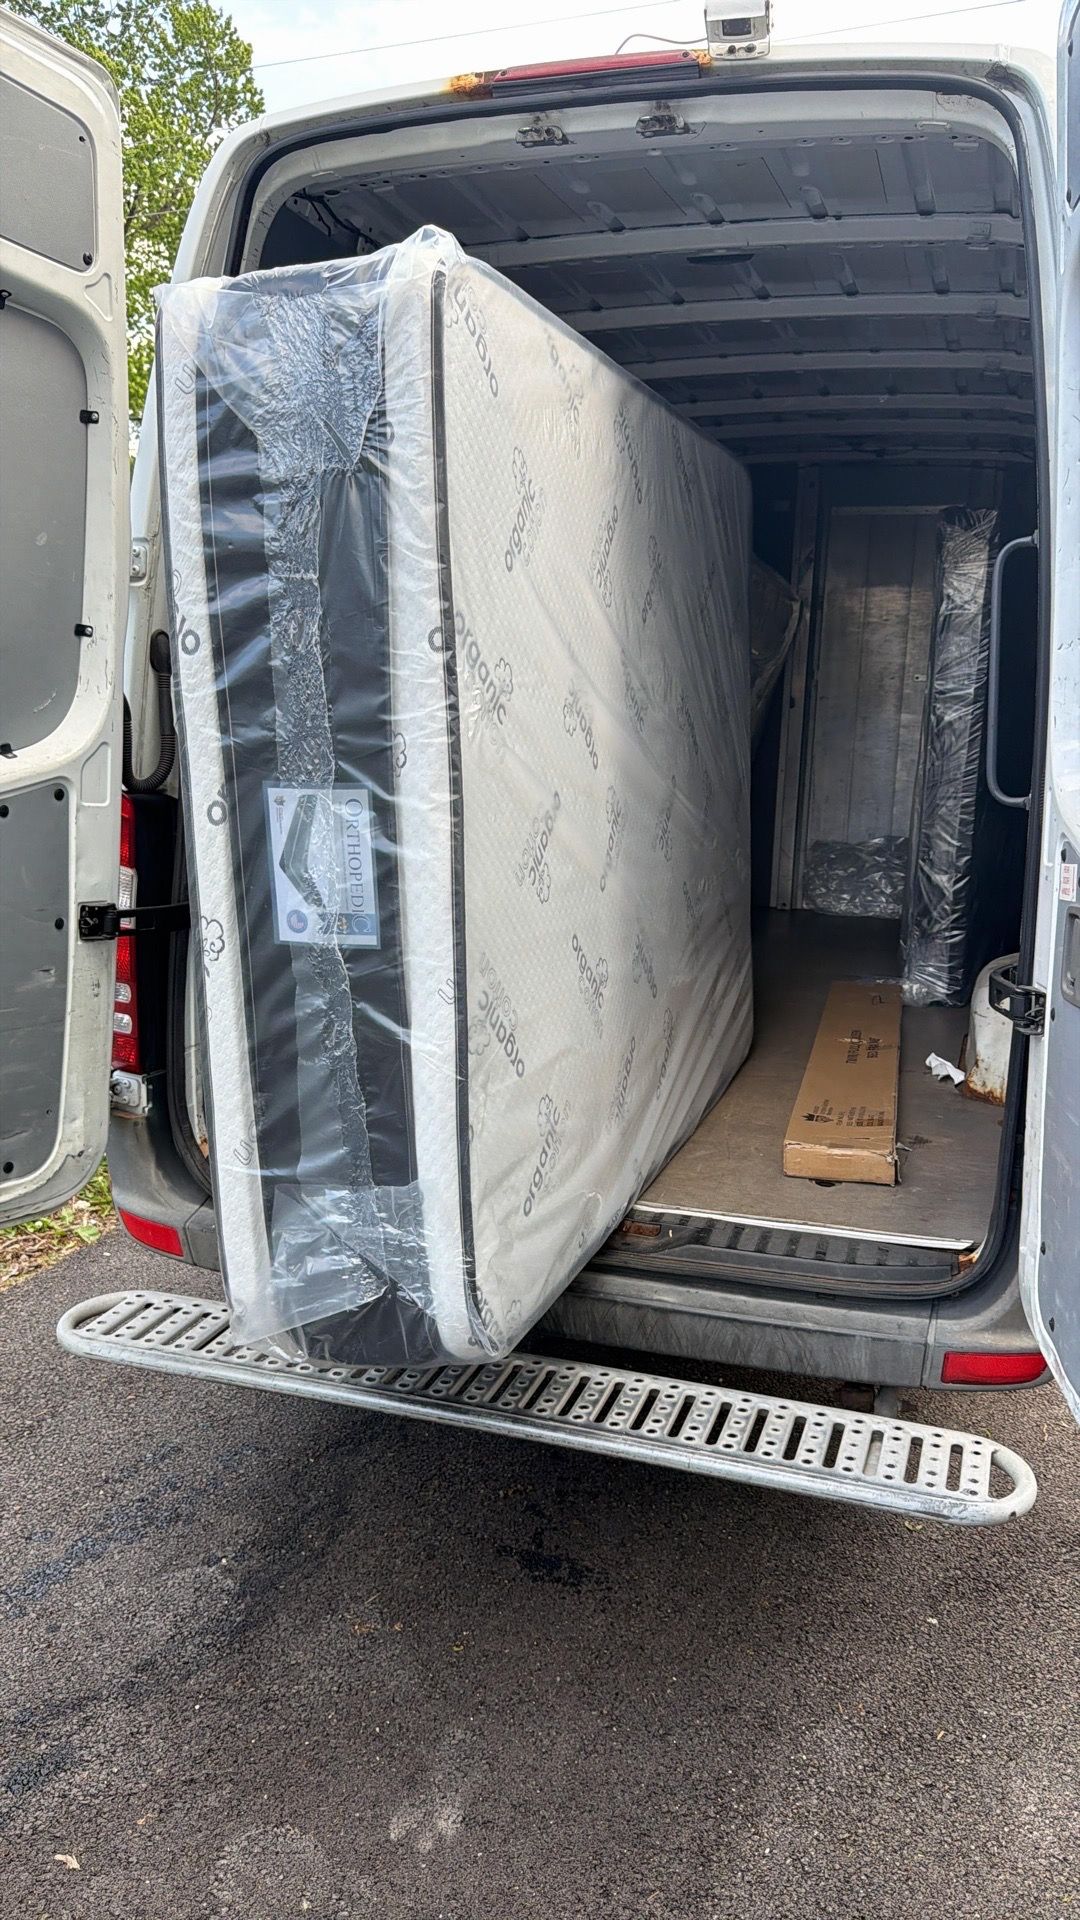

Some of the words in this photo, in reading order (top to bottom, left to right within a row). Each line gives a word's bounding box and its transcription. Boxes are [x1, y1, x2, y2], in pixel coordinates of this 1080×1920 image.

[453, 277, 498, 398] organ
[504, 478, 536, 573] organic
[597, 504, 619, 582] organic
[454, 611, 507, 726] organic
[567, 678, 598, 770] organic
[344, 797, 370, 934] ORTHOPEDIC
[571, 933, 604, 1009] organic
[478, 990, 525, 1078] organic
[522, 1106, 560, 1217] organic
